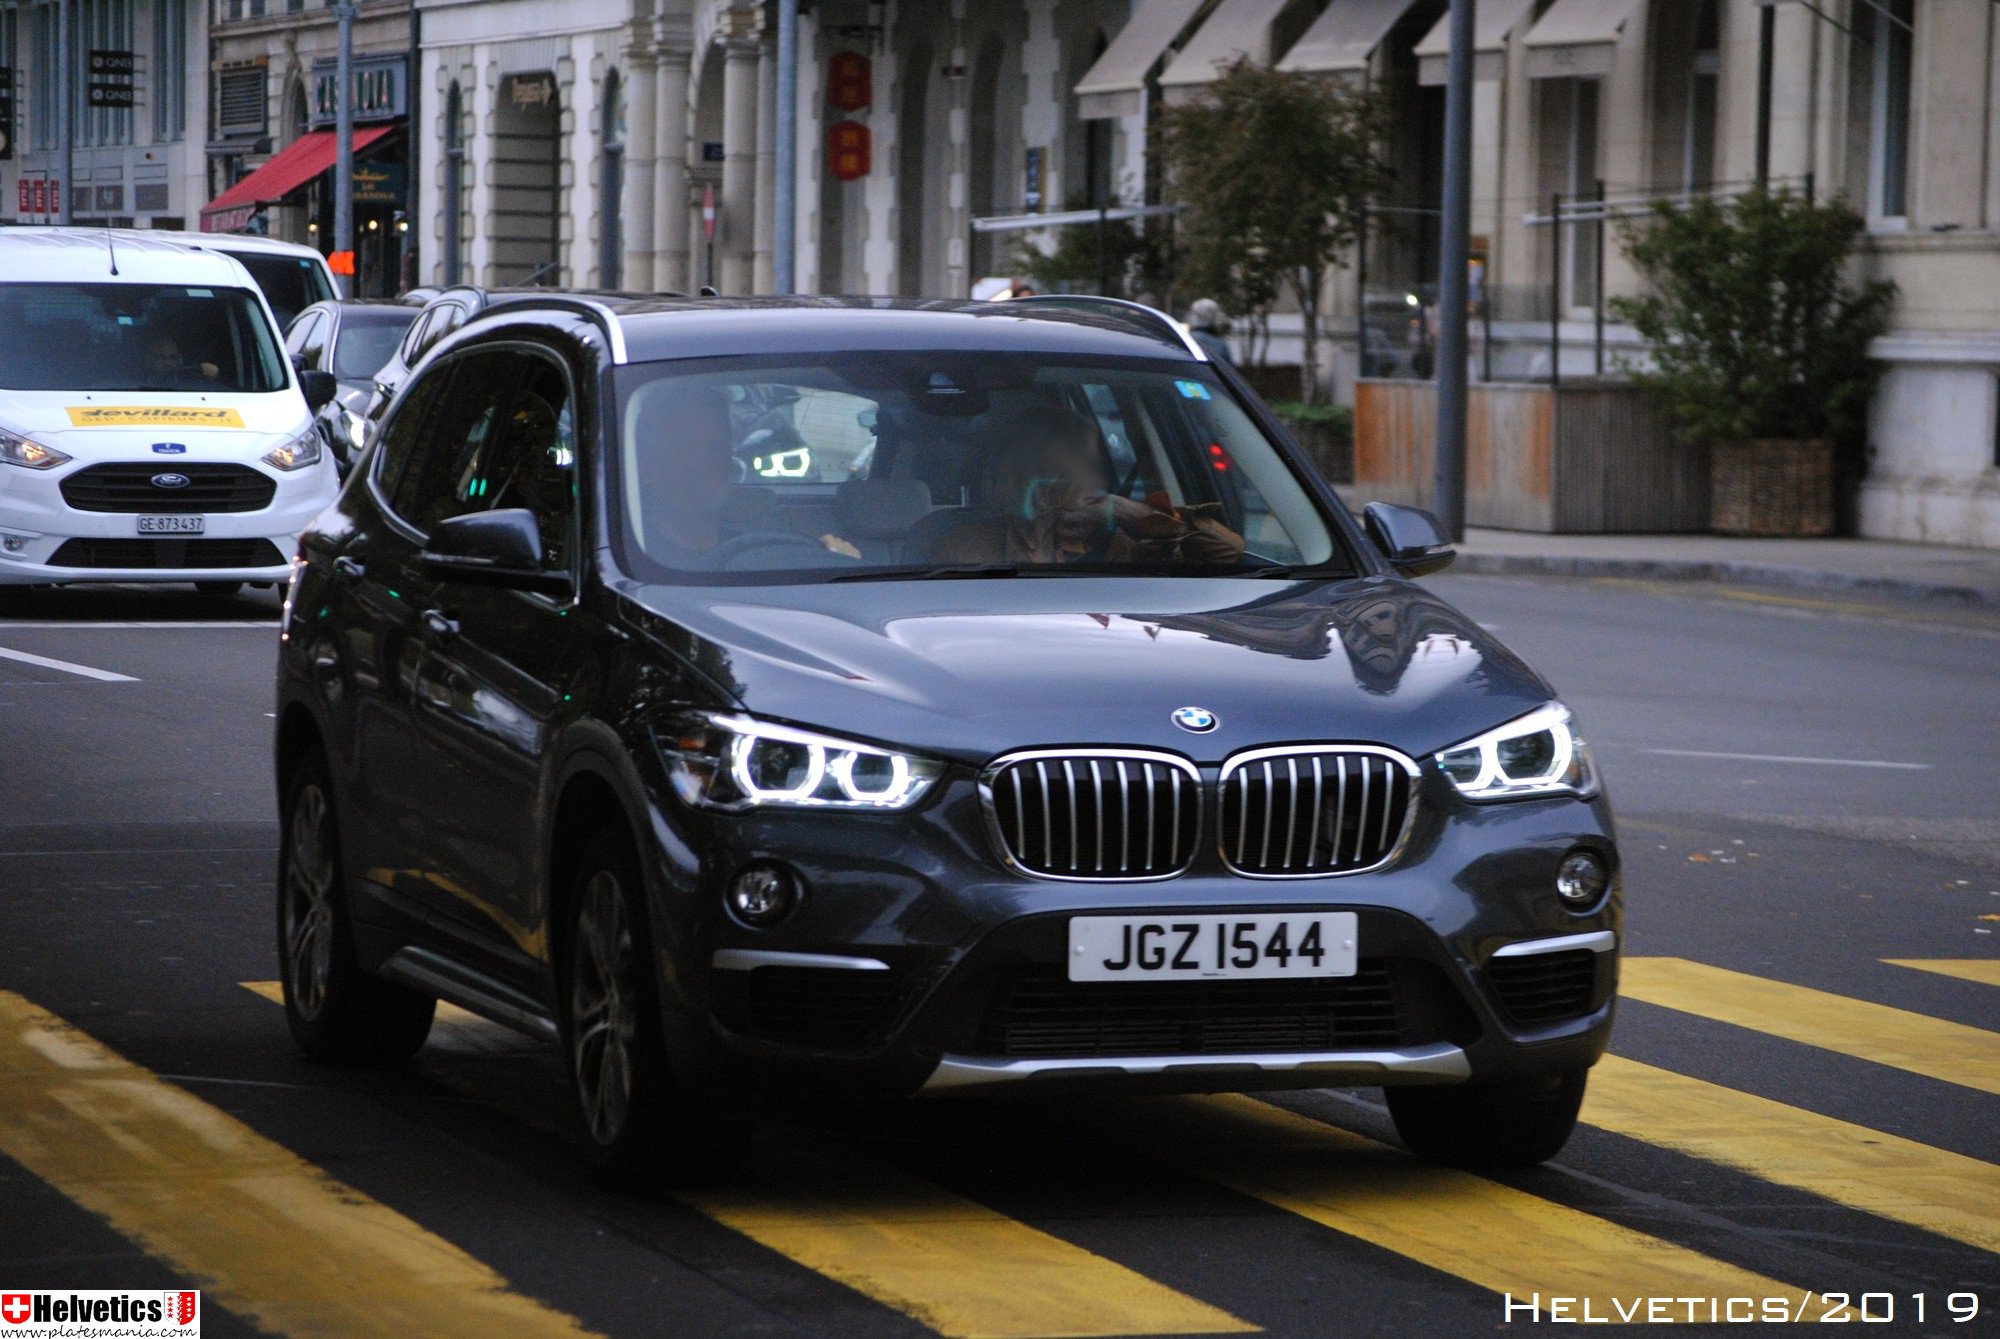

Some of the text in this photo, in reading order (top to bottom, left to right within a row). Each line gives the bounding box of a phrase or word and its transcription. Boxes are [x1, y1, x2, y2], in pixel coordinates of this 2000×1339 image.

[80, 408, 226, 418] devillard
[1103, 921, 1325, 971] JGZ 1544
